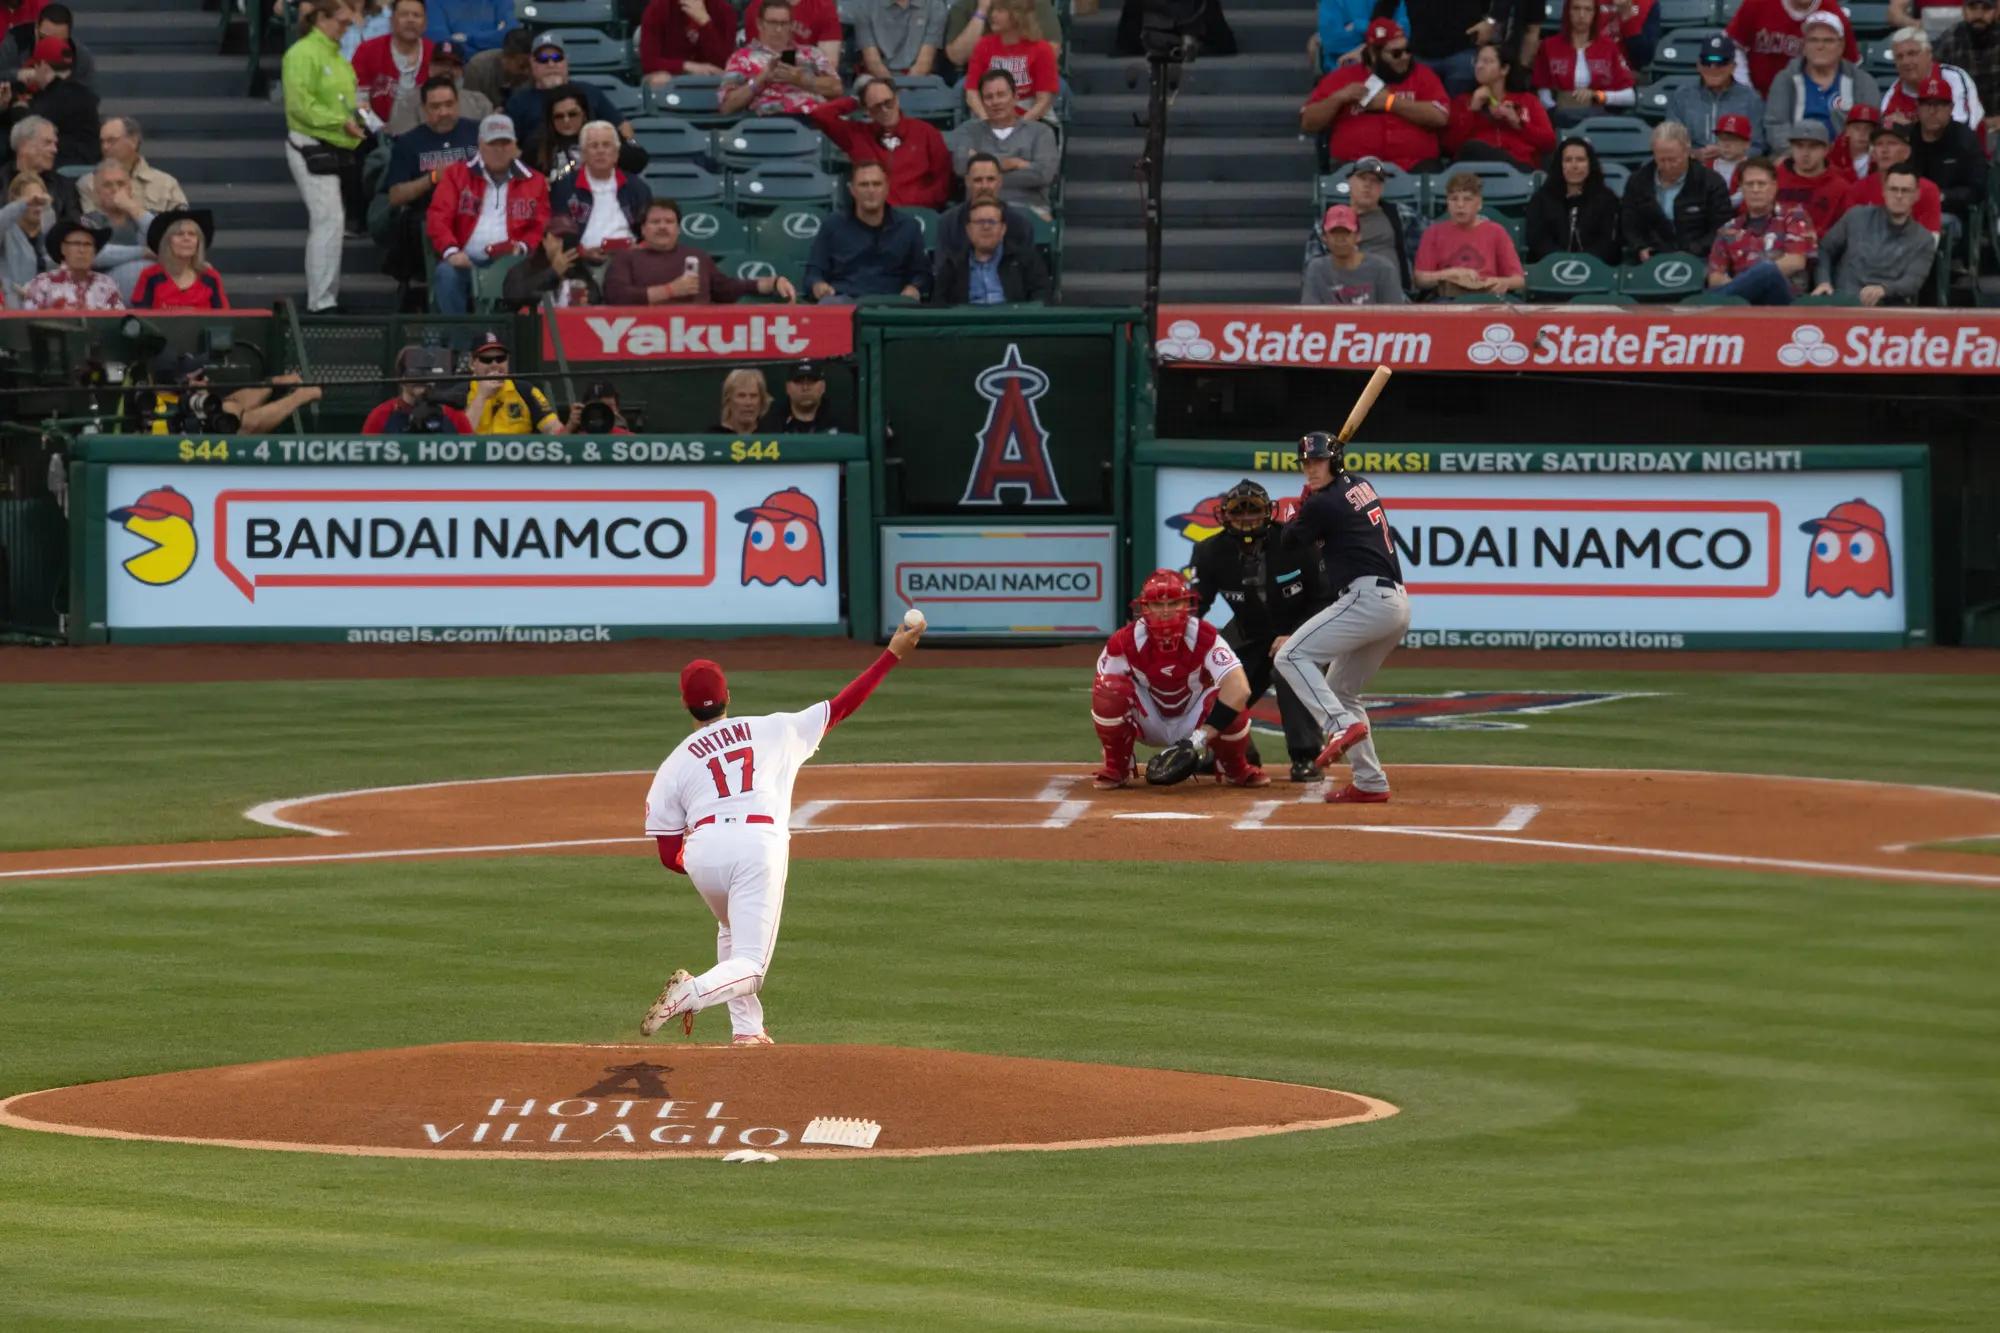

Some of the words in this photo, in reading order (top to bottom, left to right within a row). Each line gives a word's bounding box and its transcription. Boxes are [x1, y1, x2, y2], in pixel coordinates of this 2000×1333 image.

[585, 316, 810, 354] Yakult
[179, 440, 229, 461] $44
[253, 440, 270, 461] 4
[279, 440, 409, 464] TICKETS,
[419, 440, 476, 462] HOT
[485, 441, 572, 463] DOGS,
[582, 441, 602, 462] &
[612, 441, 705, 462] SODAS
[731, 440, 780, 462] $44
[1254, 451, 1430, 472] FIRORKS!
[1440, 453, 1533, 472] EVERY
[1542, 452, 1693, 472] SATURDAY
[1702, 450, 1802, 471] NIGHT!
[246, 517, 457, 559] BANDAI
[474, 517, 688, 559] NAMCO
[1367, 506, 1394, 554] 7
[1389, 526, 1517, 568] NDAI
[1534, 527, 1752, 570] NAMCO
[908, 573, 996, 592] BANDAI
[1003, 573, 1090, 592] NAMCO
[347, 625, 611, 644] angels.com/funpack
[688, 722, 753, 759] OHTANI
[706, 746, 755, 798] 17
[487, 1098, 739, 1121] HOTEL
[423, 1123, 789, 1147] VILLAGIO
